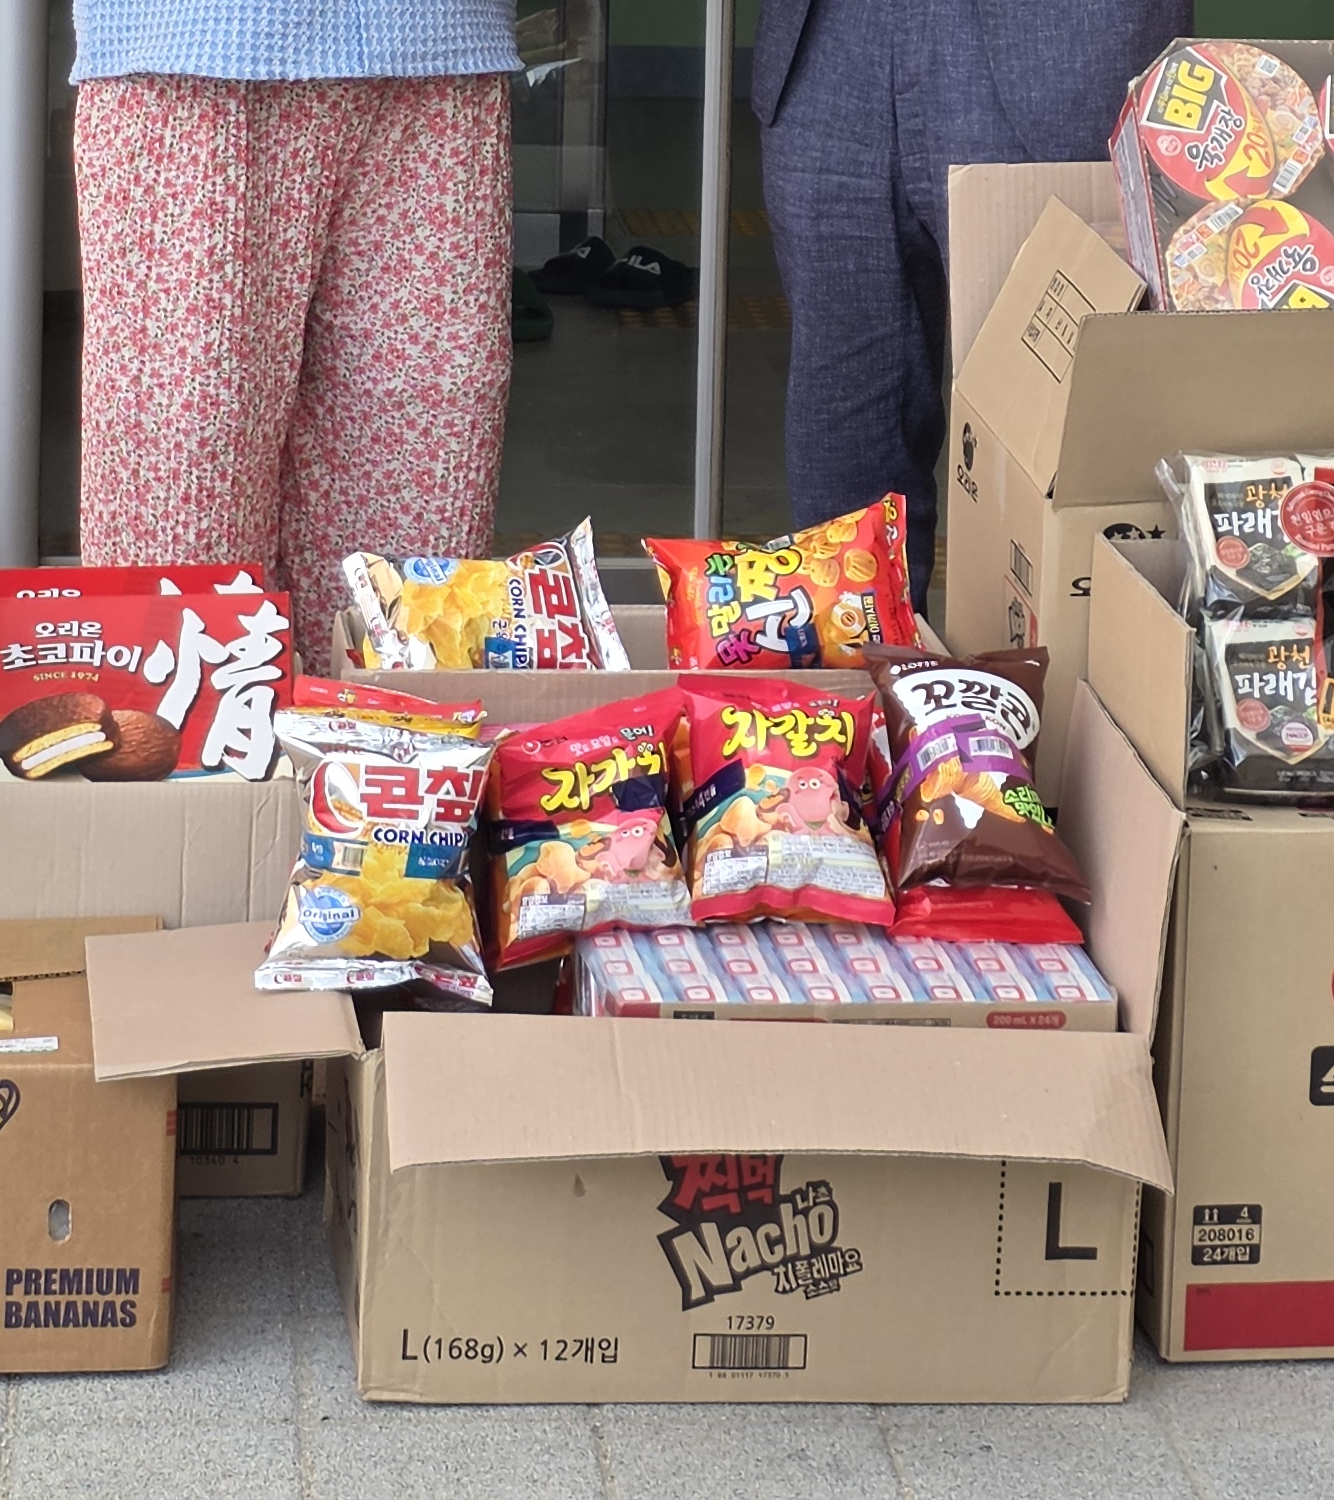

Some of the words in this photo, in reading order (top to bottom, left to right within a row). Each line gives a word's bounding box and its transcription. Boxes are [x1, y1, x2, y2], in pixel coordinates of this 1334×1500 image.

[1163, 60, 1215, 130] BIG
[509, 577, 525, 620] CORN
[35, 621, 103, 638] 오리온
[0, 639, 143, 673] 초코파이
[1268, 644, 1312, 671] 광천
[32, 671, 67, 683] SINCE
[70, 670, 100, 683] 1974
[143, 599, 291, 781] 情
[910, 678, 1031, 741] 꼬깔콘
[721, 705, 855, 758] 자갈치
[359, 764, 491, 824] 콘칩
[373, 827, 425, 845] CORN
[302, 906, 355, 922] Original
[1045, 1181, 1098, 1261] L
[1197, 1228, 1255, 1244] 208016
[672, 1203, 835, 1301] Nacho
[1202, 1247, 1251, 1264] 24개입
[5, 1267, 140, 1297] PREMIUM
[774, 1250, 862, 1293] 치폴레마요
[5, 1299, 137, 1330] BANANAS
[727, 1315, 776, 1331] 17379
[399, 1328, 505, 1366] L(168g)
[539, 1338, 620, 1365] 12개입
